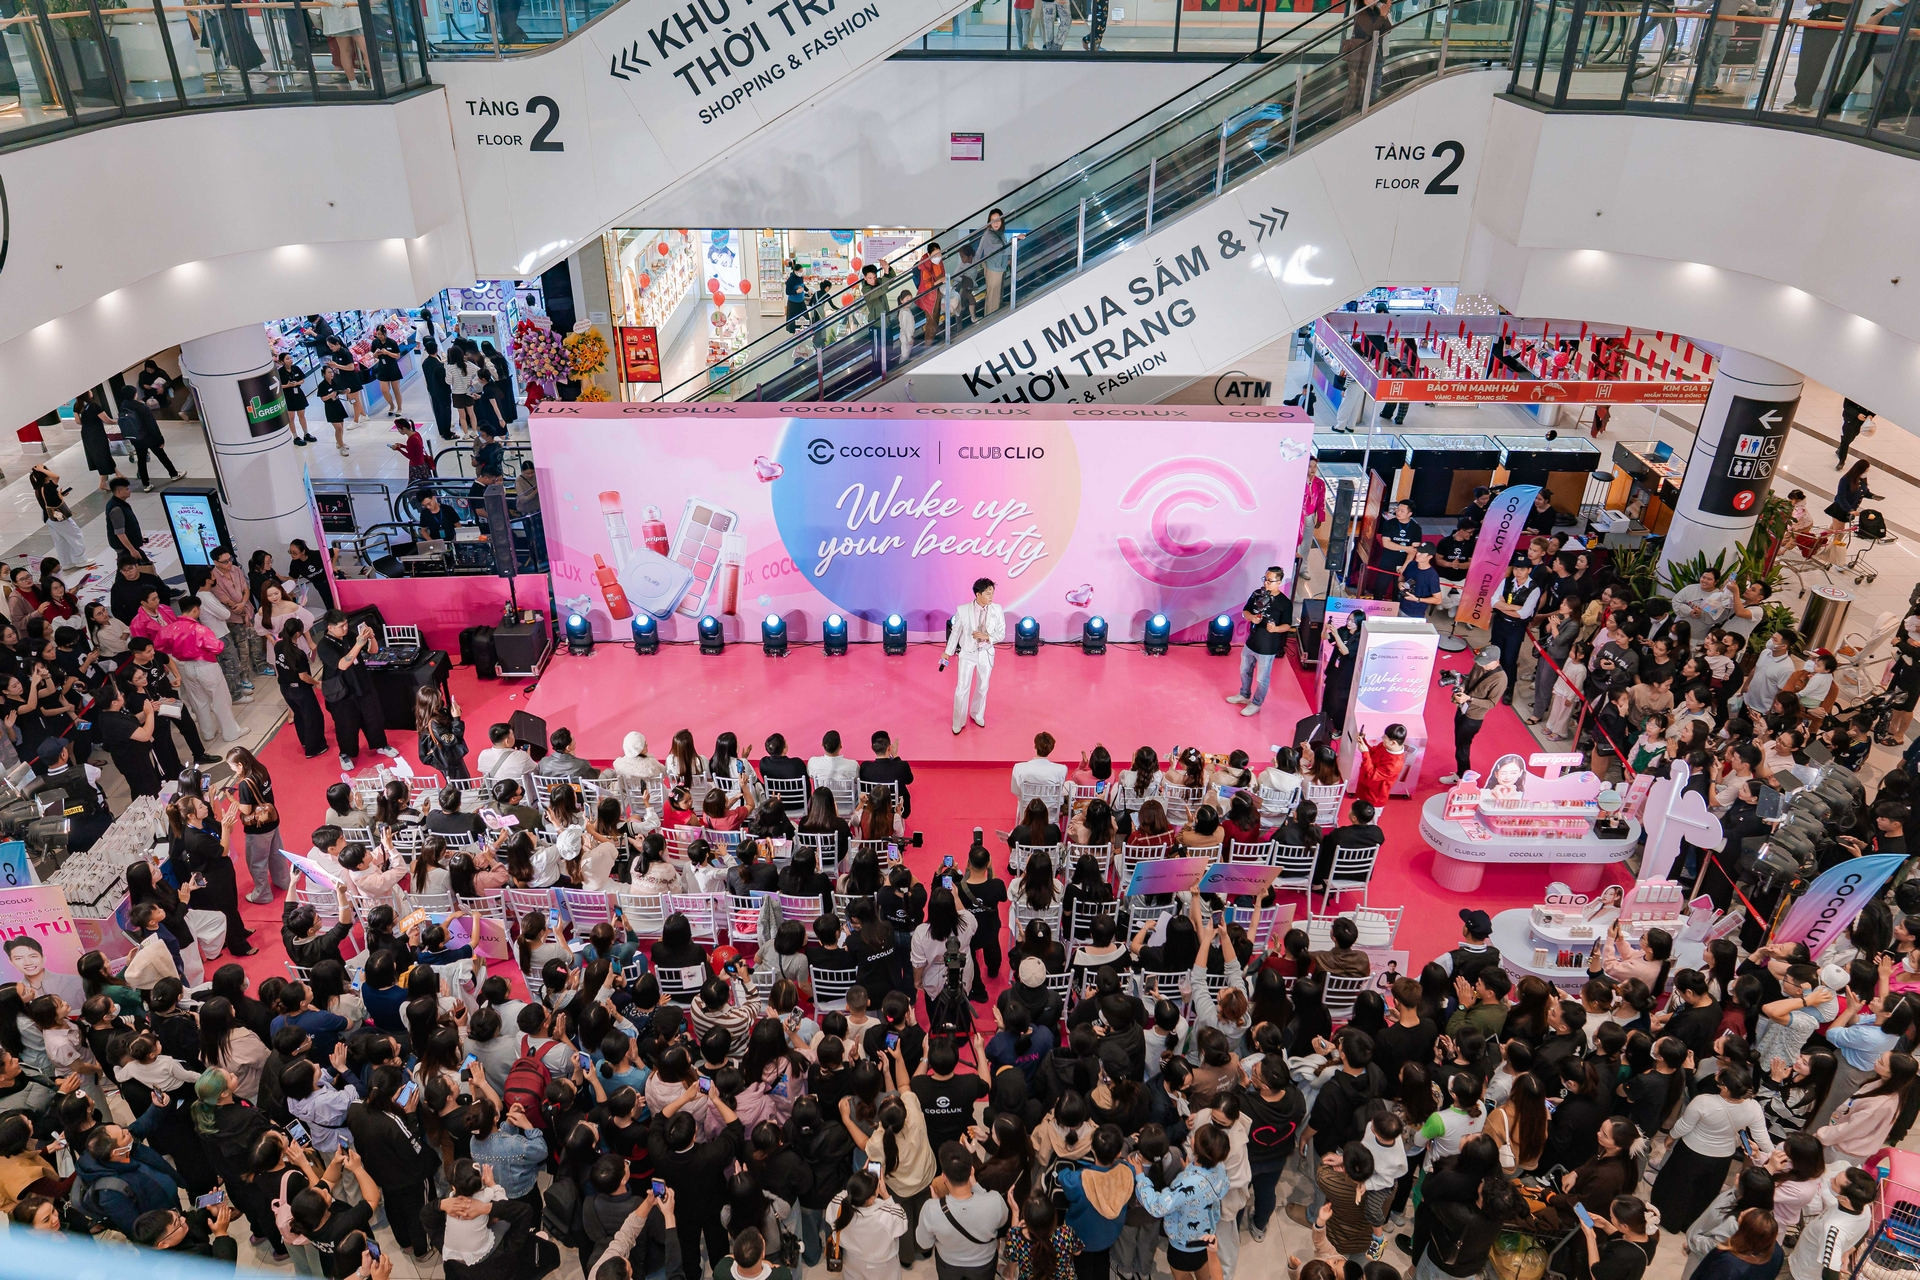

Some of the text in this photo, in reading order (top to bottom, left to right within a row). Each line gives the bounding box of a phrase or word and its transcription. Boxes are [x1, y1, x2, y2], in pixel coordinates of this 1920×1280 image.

[648, 0, 730, 59] KHU
[673, 21, 771, 96] THỜI
[699, 3, 880, 124] SHOPPING & FASHION
[525, 95, 565, 152] 2
[477, 134, 523, 146] FLOOR
[1424, 140, 1465, 195] 2
[1375, 178, 1420, 190] FLOOR
[962, 338, 1038, 397] KHU
[1042, 293, 1125, 354] MUA
[1219, 229, 1246, 259] &
[1071, 297, 1197, 382] TRANG
[1097, 350, 1168, 397] FASHION
[1225, 379, 1271, 398] ATM
[1451, 382, 1467, 392] TÍN
[1469, 384, 1500, 394] MẠNH
[258, 404, 281, 417] GREEN
[916, 407, 1032, 416] COCOLUX
[1073, 408, 1189, 417] COCOLUX
[840, 446, 920, 458] COCOLUX
[835, 475, 1033, 536] Wake up
[1492, 496, 1520, 554] COCOLUX
[814, 519, 1049, 578] your beauty
[1365, 672, 1424, 687] Wake up
[1359, 683, 1427, 699] your beauty
[1546, 894, 1588, 905] CLIO
[33, 917, 72, 937] TÚ
[457, 933, 500, 942] COLUX
